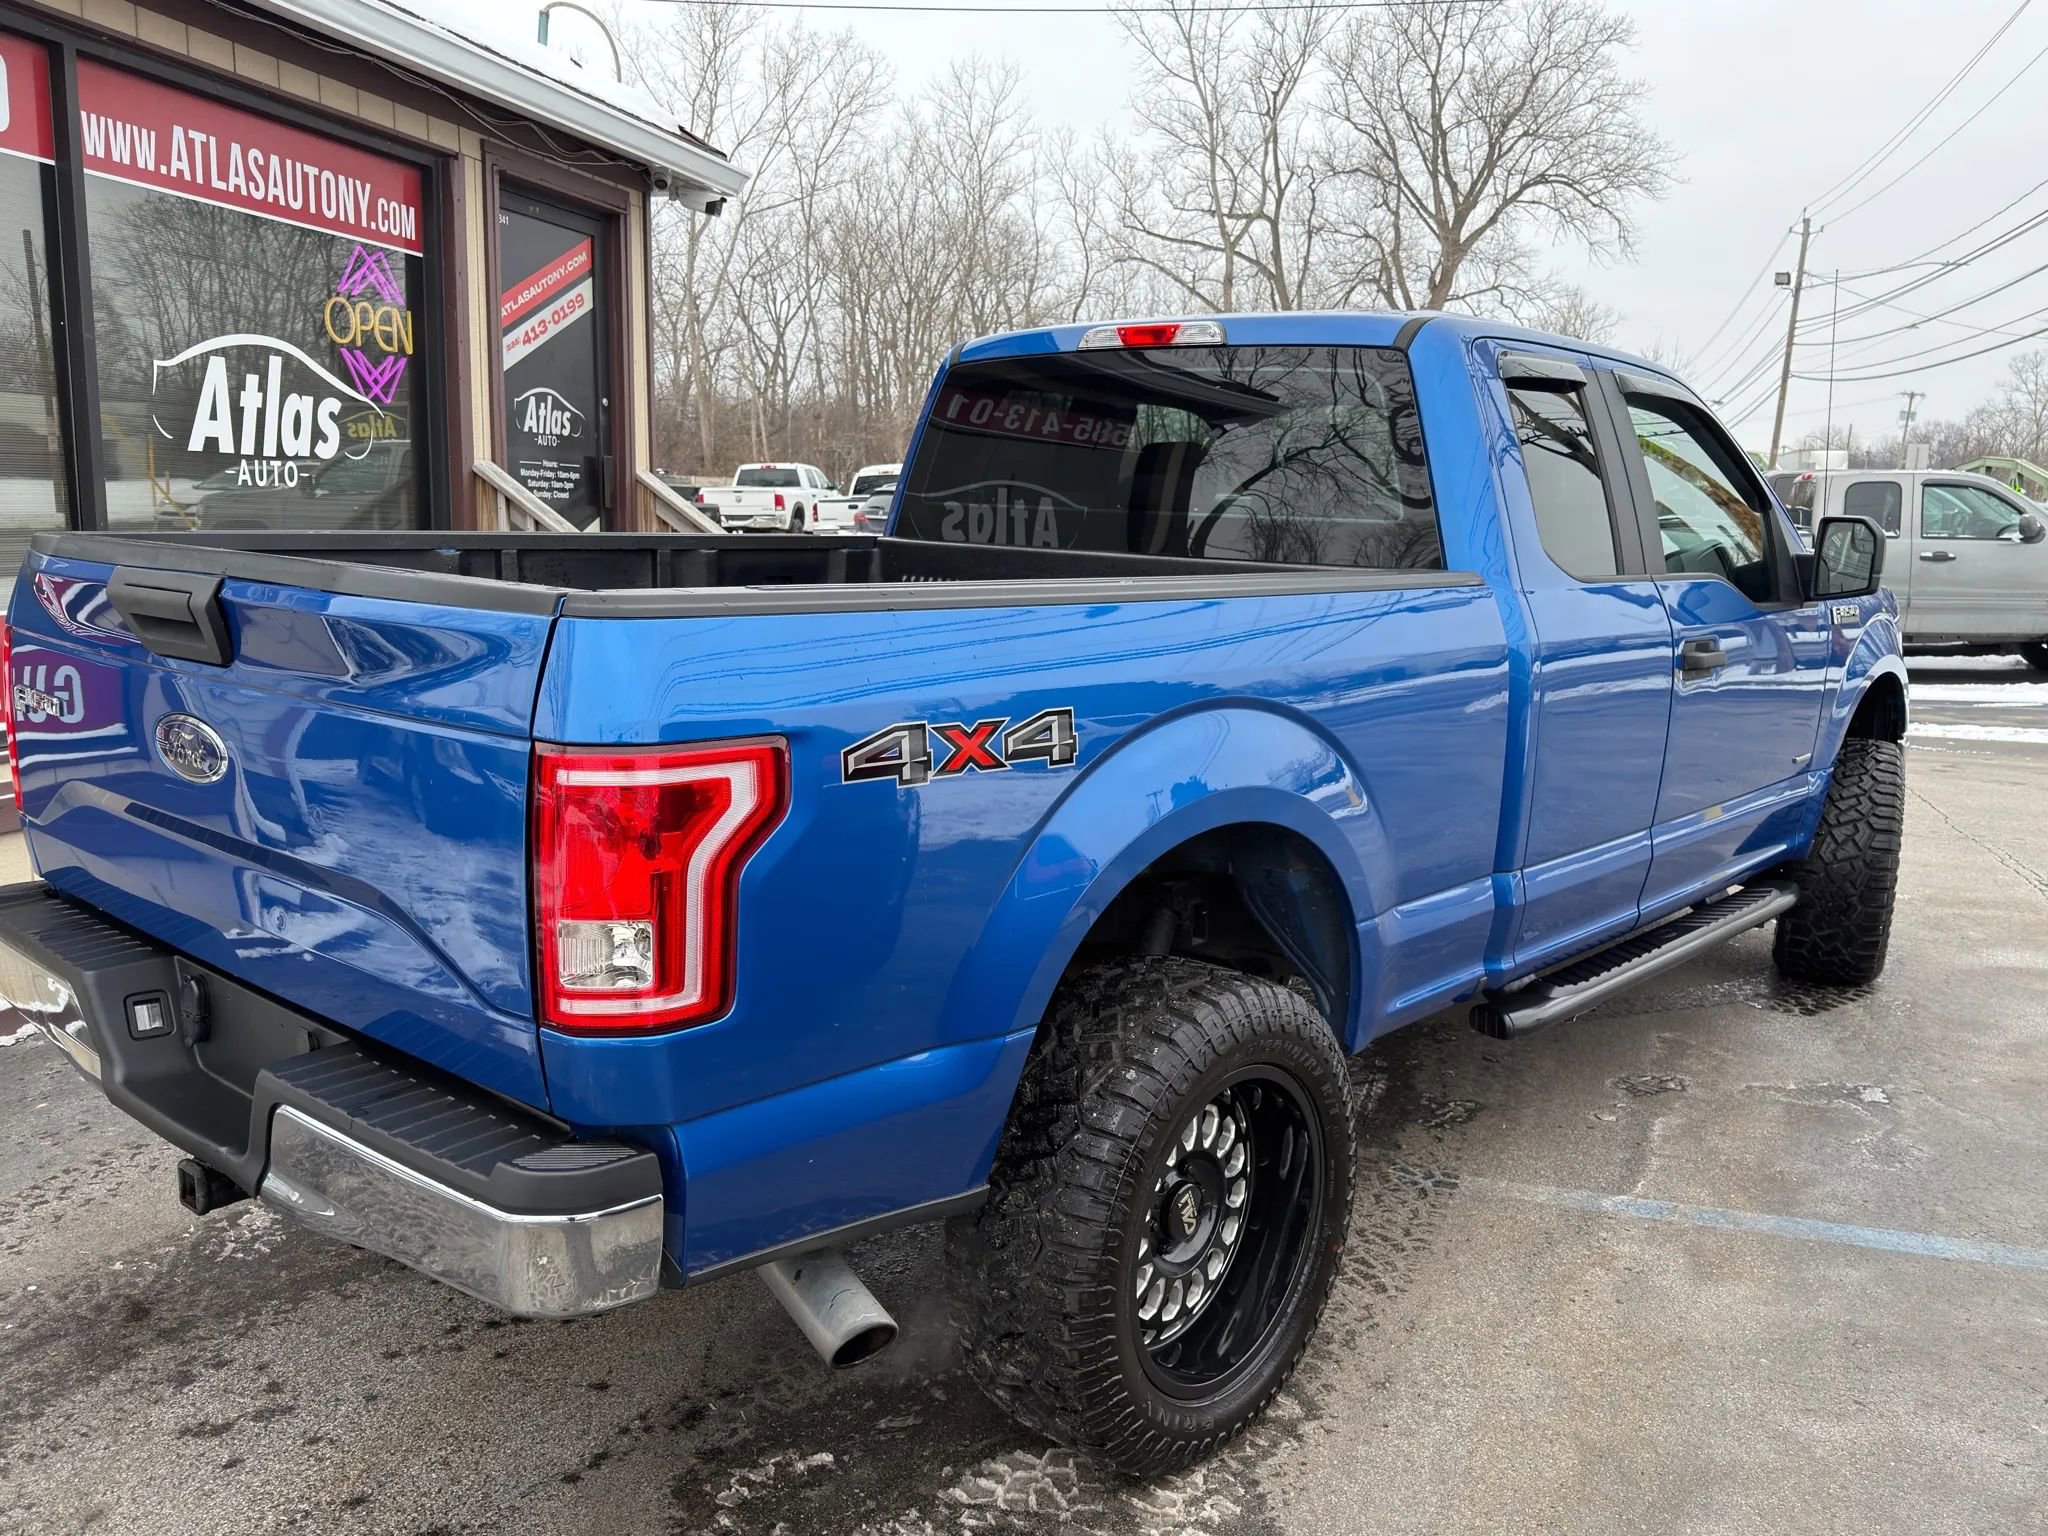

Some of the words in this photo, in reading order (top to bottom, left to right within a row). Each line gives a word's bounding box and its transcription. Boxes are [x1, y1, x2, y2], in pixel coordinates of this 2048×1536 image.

[501, 251, 587, 319] ATLASAUTONY.COM
[323, 295, 414, 356] OPEN
[522, 293, 584, 346] 413-0199
[187, 354, 341, 461] Atlas
[524, 396, 572, 437] Atlas
[520, 468, 557, 479] Monday-Friday:
[527, 479, 550, 489] Saturday:
[542, 459, 559, 468] Hours:
[553, 490, 570, 499] Closed
[166, 728, 204, 769] Ford
